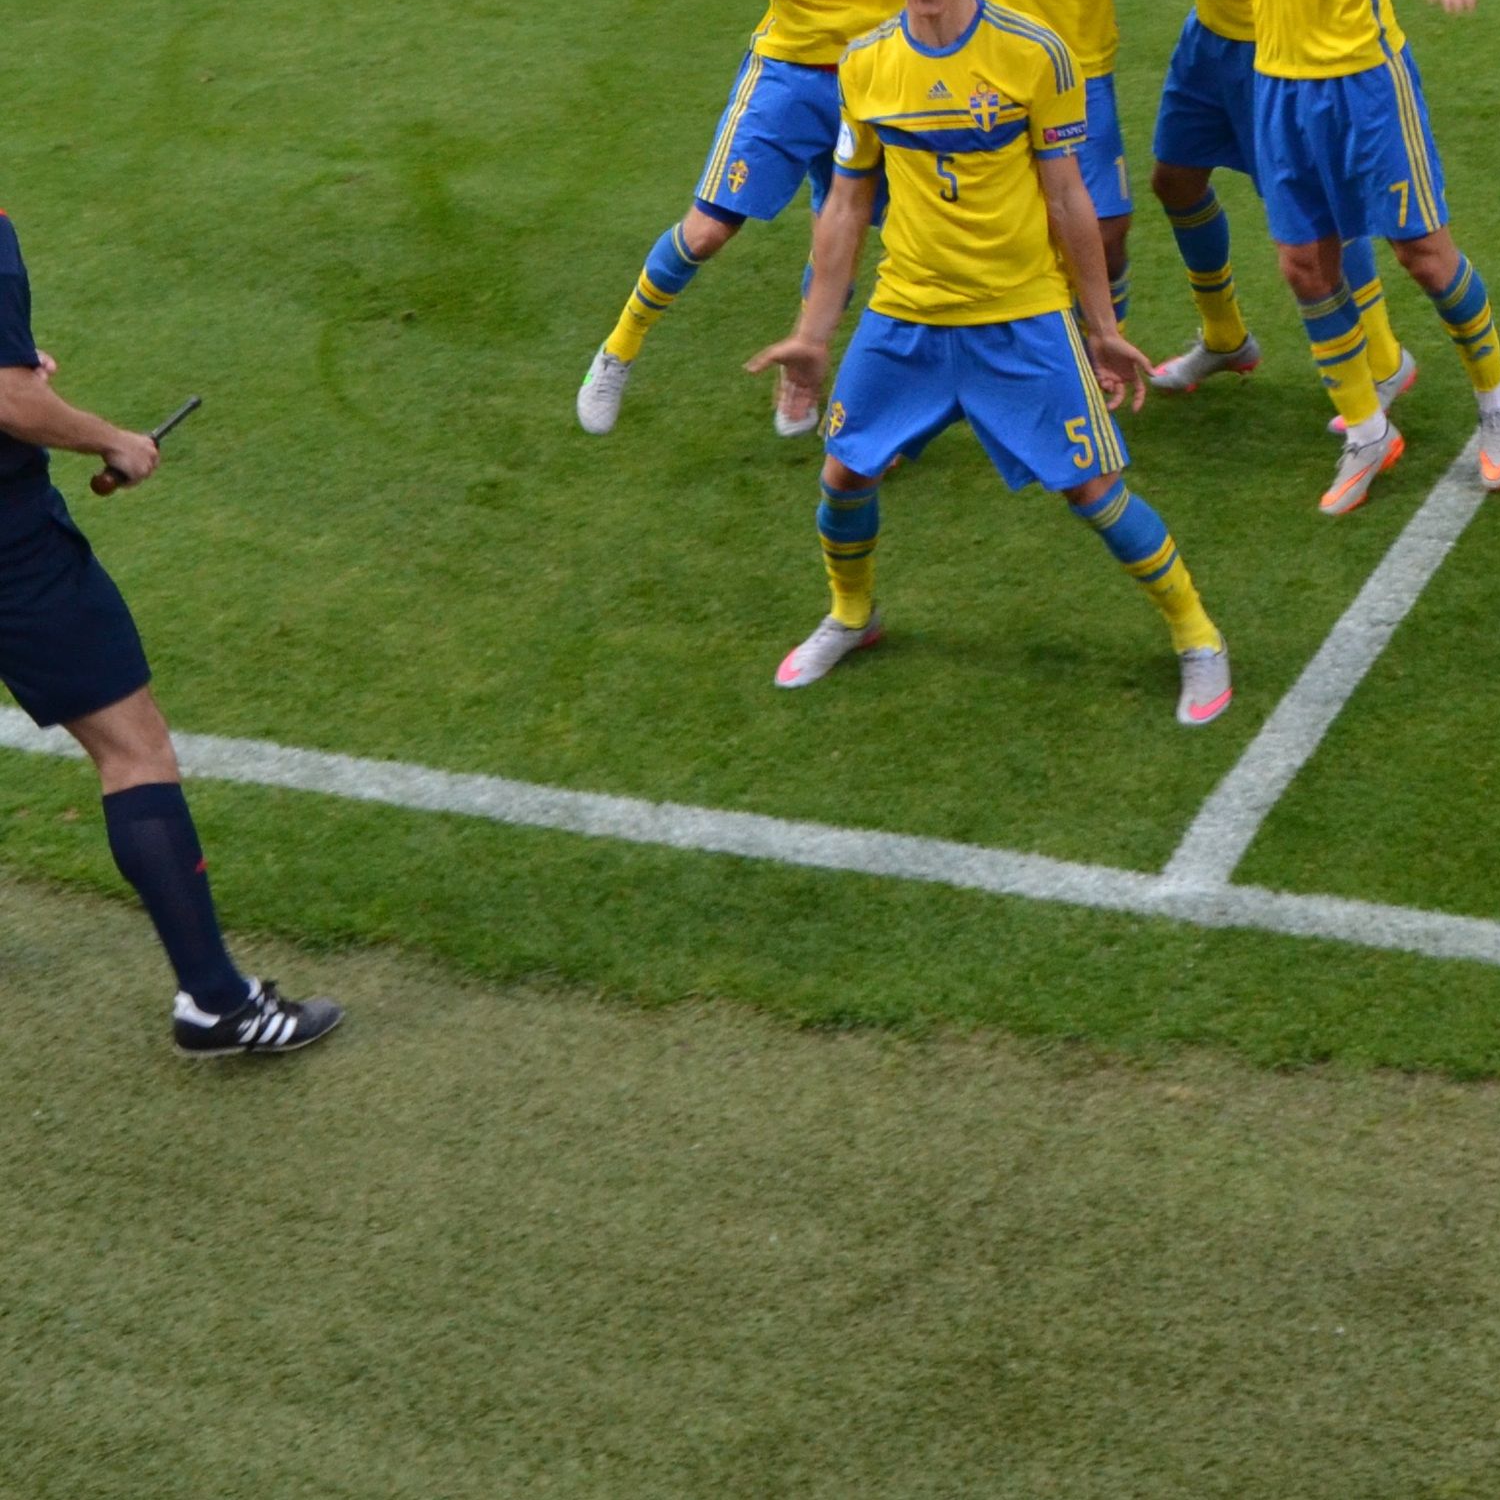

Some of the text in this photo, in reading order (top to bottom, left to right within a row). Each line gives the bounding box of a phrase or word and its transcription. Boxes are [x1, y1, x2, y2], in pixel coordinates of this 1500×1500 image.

[937, 155, 958, 202] 5
[1390, 180, 1409, 228] 7
[1065, 416, 1094, 469] 5
